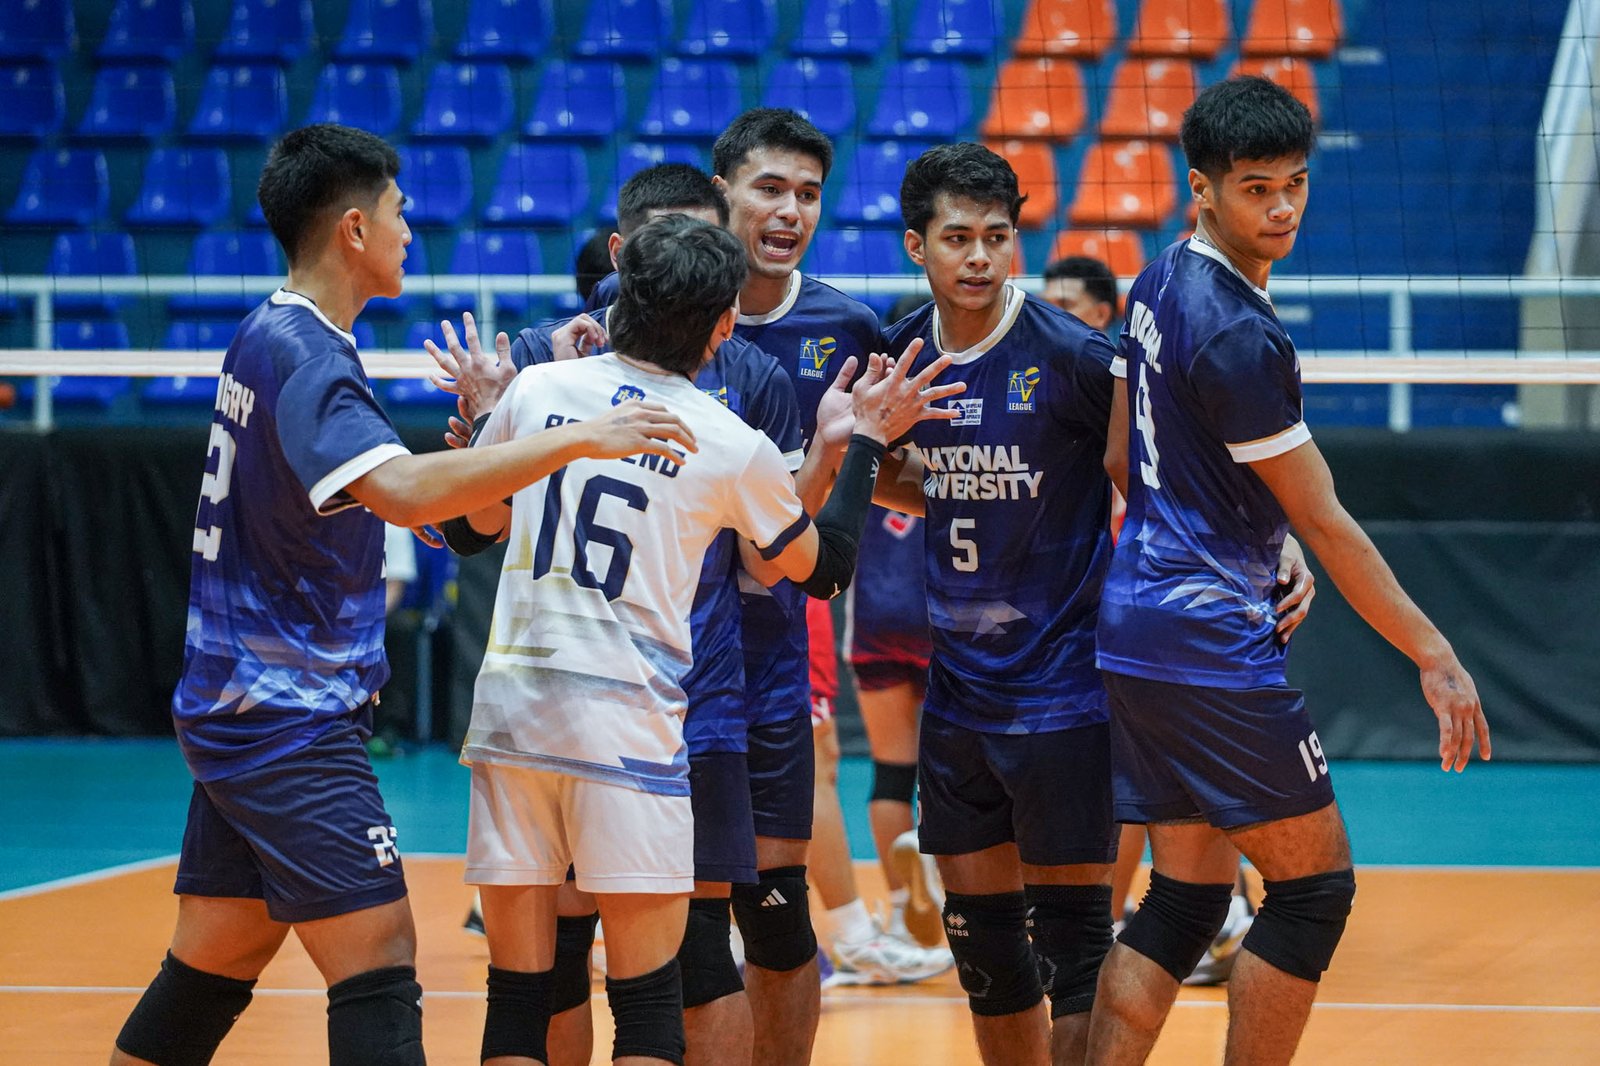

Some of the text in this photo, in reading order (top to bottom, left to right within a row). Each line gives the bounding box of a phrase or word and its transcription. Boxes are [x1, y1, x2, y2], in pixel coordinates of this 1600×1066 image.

[800, 367, 824, 379] LEAGUE
[1008, 402, 1033, 411] LEAGUE
[918, 445, 1029, 472] NATONAL
[533, 465, 649, 602] 16
[950, 518, 979, 572] 5
[1298, 730, 1328, 782] 19
